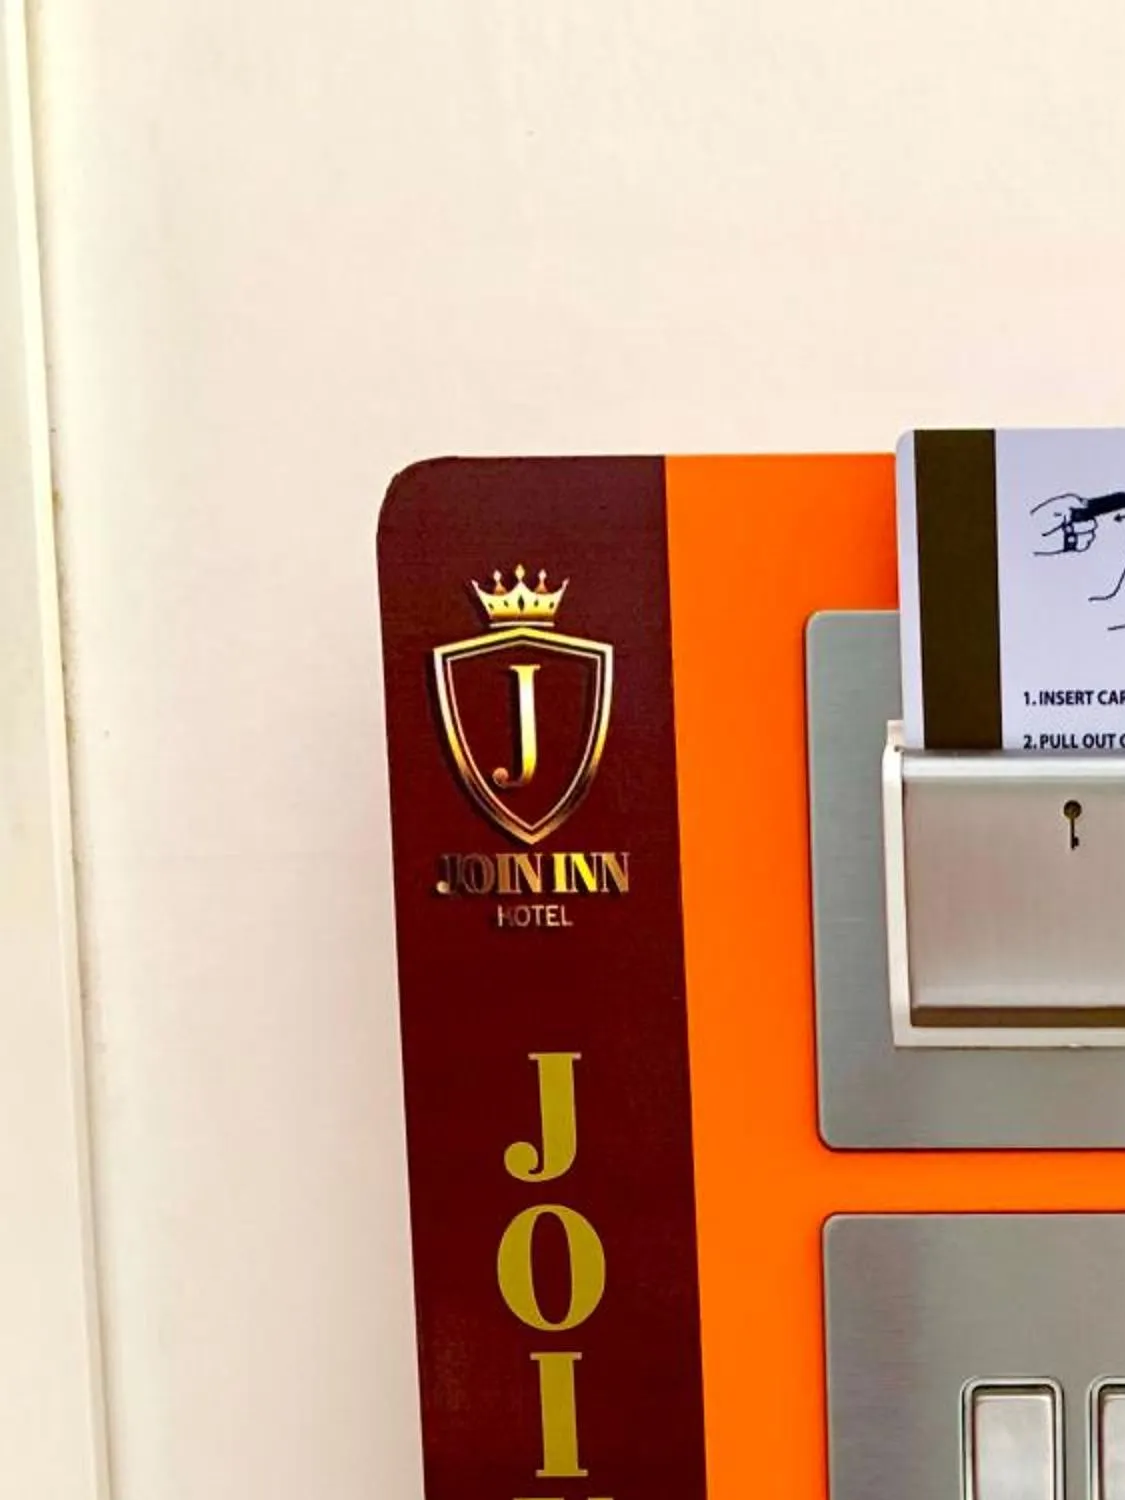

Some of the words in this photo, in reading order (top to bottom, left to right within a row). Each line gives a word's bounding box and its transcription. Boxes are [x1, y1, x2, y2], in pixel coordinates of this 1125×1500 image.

[1023, 690, 1037, 705] 1.
[1039, 690, 1095, 705] INSERT
[492, 664, 541, 788] J
[1023, 734, 1038, 749] 2.
[1040, 734, 1079, 749] PULL
[1083, 734, 1115, 749] OUT
[436, 852, 543, 895] JOIN
[553, 852, 630, 894] INN
[497, 904, 573, 927] HOTEL
